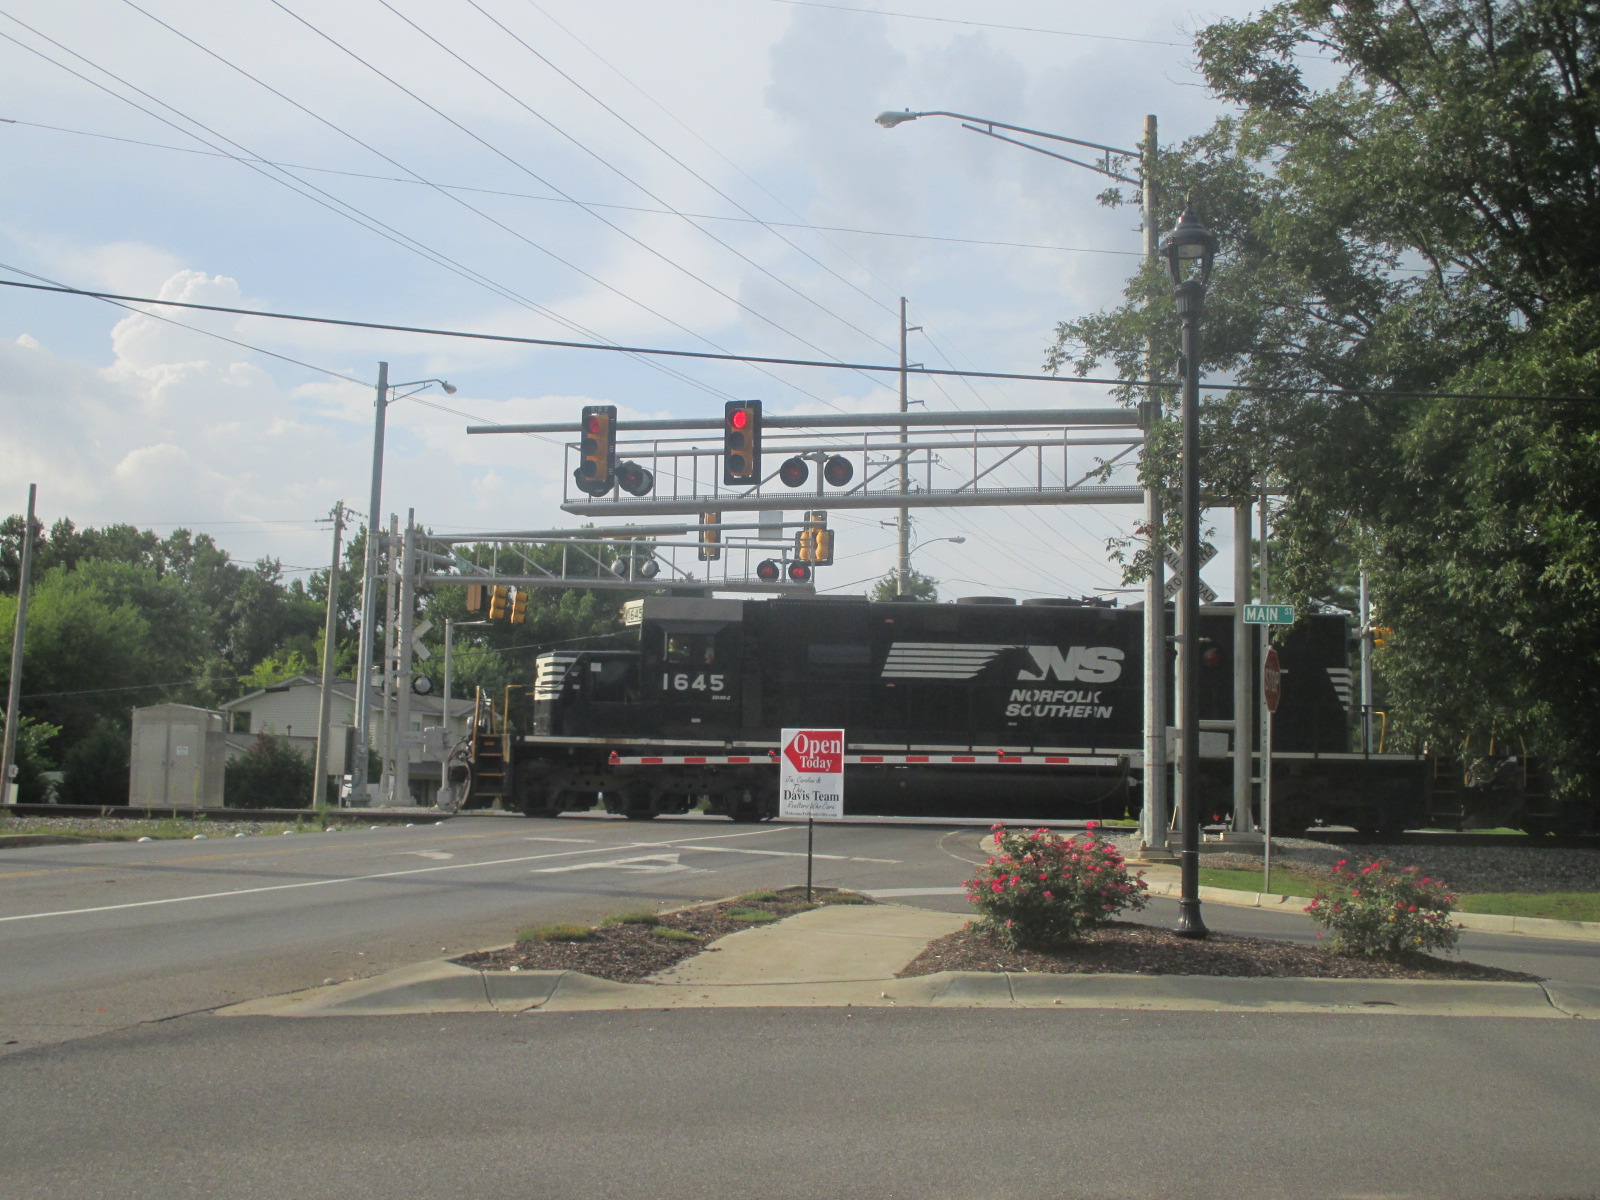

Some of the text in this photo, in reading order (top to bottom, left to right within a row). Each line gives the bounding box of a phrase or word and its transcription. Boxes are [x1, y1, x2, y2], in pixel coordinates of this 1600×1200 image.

[1246, 607, 1293, 621] MAIN ST
[1017, 645, 1125, 683] NS
[663, 673, 724, 691] 1645
[1009, 689, 1102, 703] NORFOLK
[1005, 703, 1113, 718] SOUTHERN
[793, 733, 841, 759] Open
[800, 756, 832, 771] Today
[784, 790, 840, 801] Davis Team
